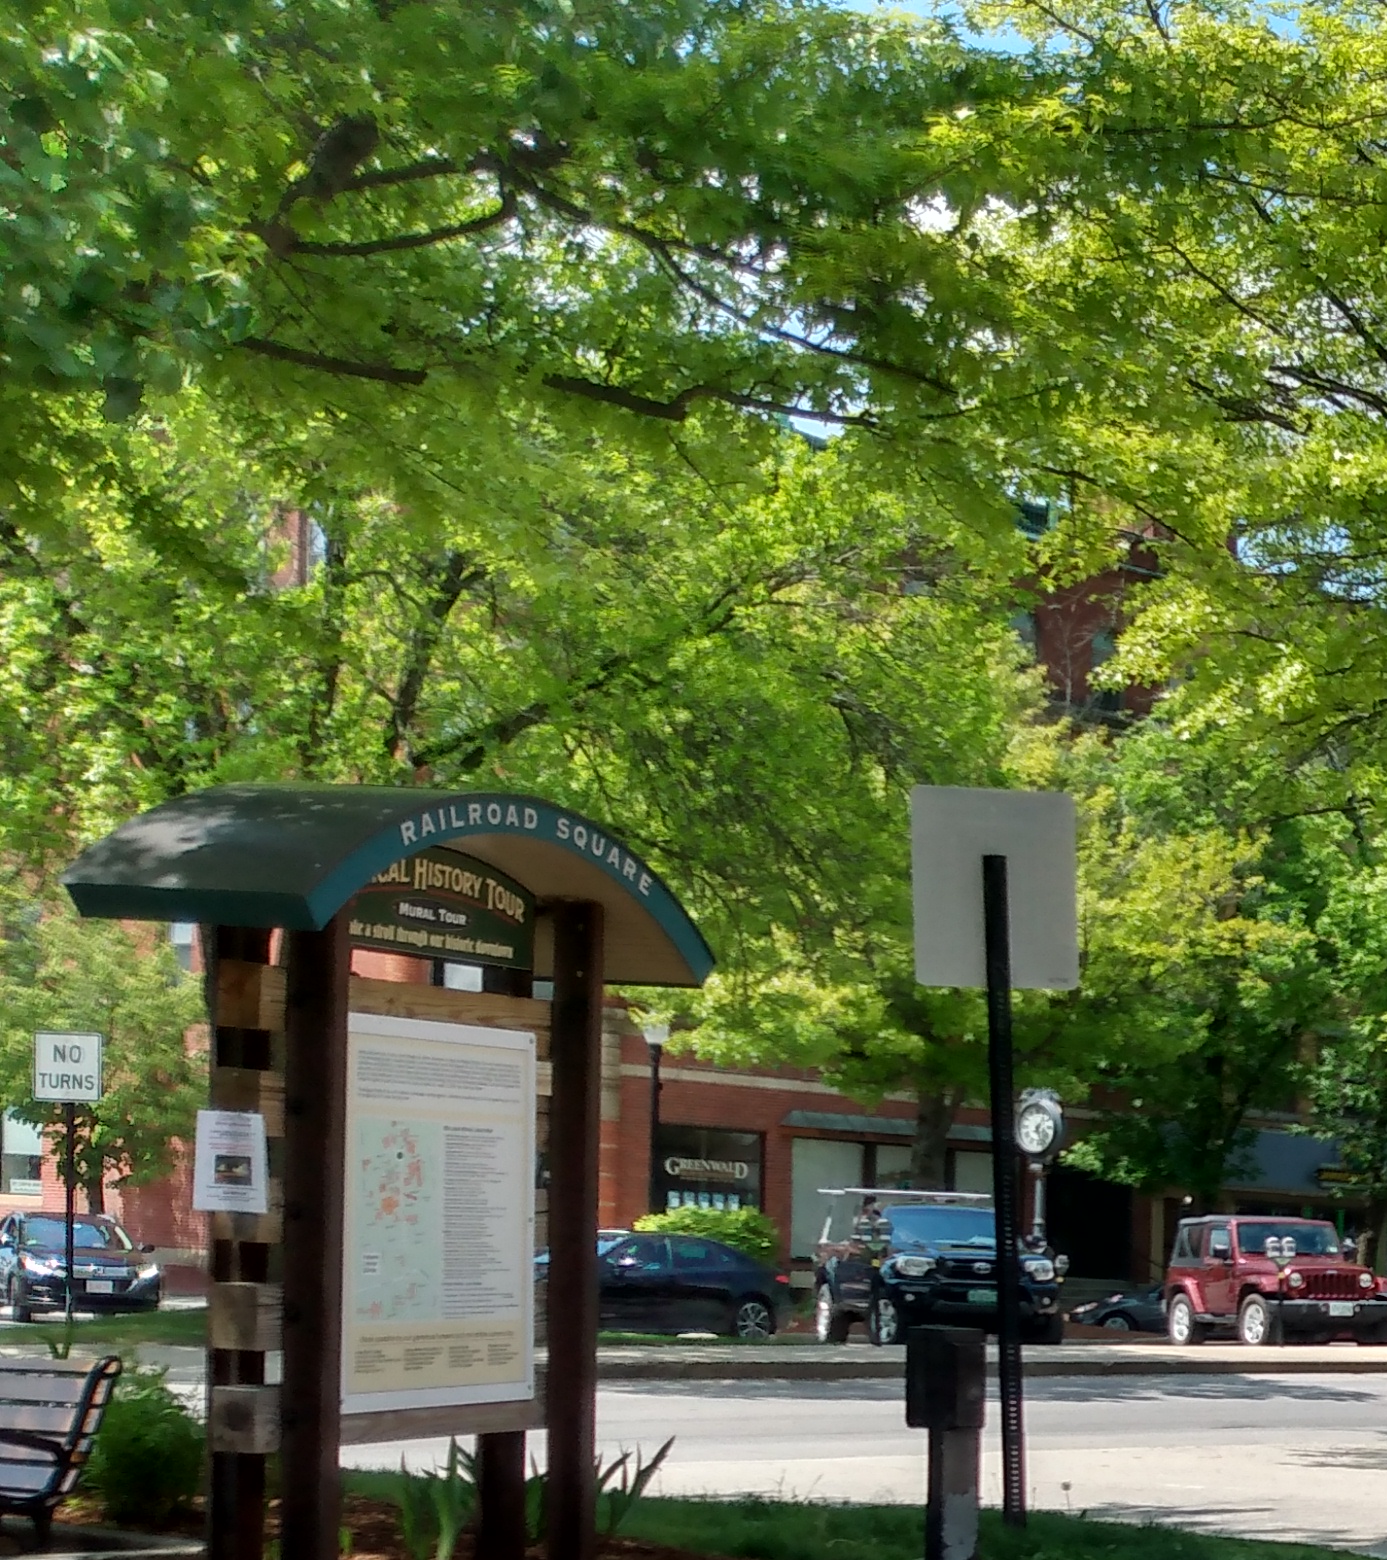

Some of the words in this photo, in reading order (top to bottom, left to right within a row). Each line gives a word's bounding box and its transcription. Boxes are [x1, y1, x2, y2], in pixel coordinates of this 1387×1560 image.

[400, 802, 539, 847] RAILROAD
[556, 817, 653, 897] SQUARE
[414, 857, 482, 899] HISTORY
[486, 877, 526, 924] TOUR
[398, 901, 436, 922] MURAL
[438, 907, 467, 926] TOUR
[53, 1044, 82, 1064] NO
[38, 1072, 95, 1091] TURNS
[664, 1156, 749, 1180] GREENWALD
